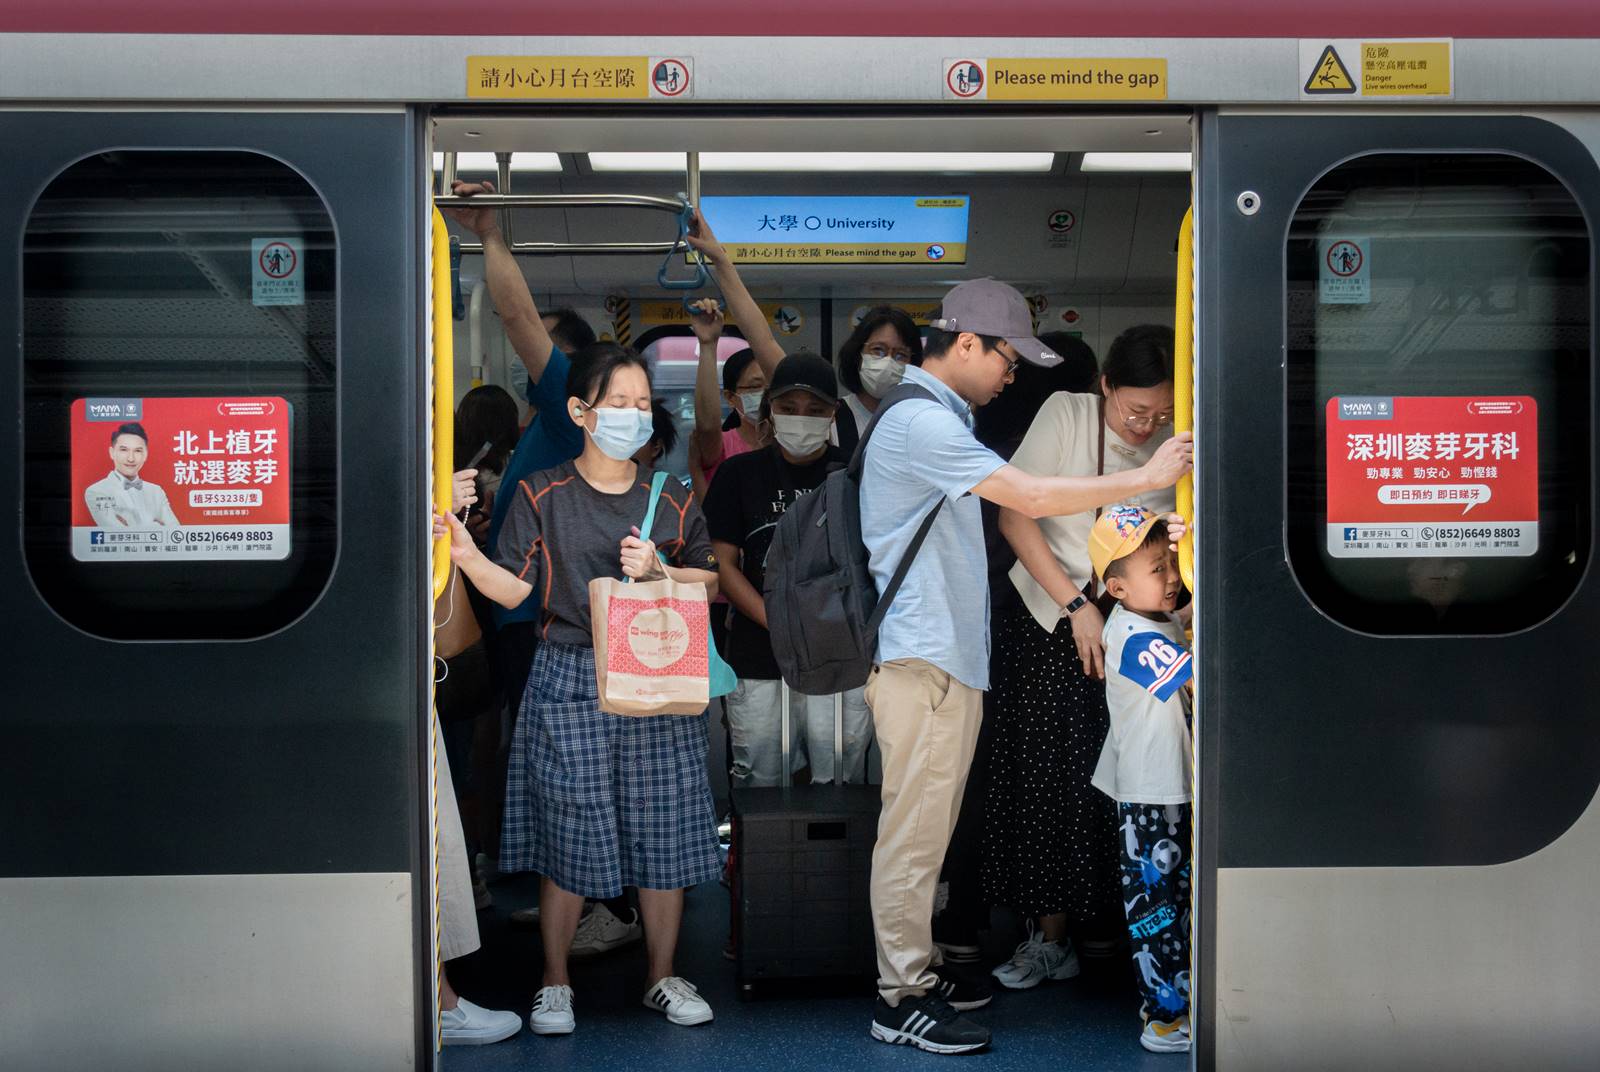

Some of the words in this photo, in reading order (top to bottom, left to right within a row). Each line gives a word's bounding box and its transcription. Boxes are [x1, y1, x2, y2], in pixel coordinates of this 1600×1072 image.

[1366, 47, 1389, 58] 危險
[480, 67, 636, 89] 請小心月台空隙
[994, 70, 1046, 85] Please
[1050, 70, 1093, 85] mind
[1097, 70, 1124, 85] the
[1128, 73, 1160, 88] gap
[1365, 74, 1392, 82] Danger
[757, 214, 799, 232] 大學
[827, 217, 896, 232] University
[736, 247, 822, 258] 請小心月台空隙
[825, 248, 854, 257] Please
[855, 248, 880, 257] mind
[881, 248, 898, 257] the
[898, 249, 917, 259] gap
[90, 404, 121, 413] MAIYA
[1343, 403, 1373, 411] MAIYA
[173, 429, 278, 456] 北上植牙
[1346, 431, 1520, 461] 深圳麥芽牙科
[173, 458, 278, 485] 就選麥芽
[1366, 467, 1404, 480] 勁專業
[1413, 467, 1451, 480] 勁安心
[1390, 489, 1433, 500] 即日預約
[1437, 488, 1480, 500] 即日睇牙
[185, 531, 244, 544] (852)6649
[246, 531, 273, 542] 8803
[1435, 528, 1492, 541] (852)6649
[1493, 528, 1521, 539] 8803
[1138, 638, 1178, 679] 26
[1136, 906, 1177, 937] Brazil
